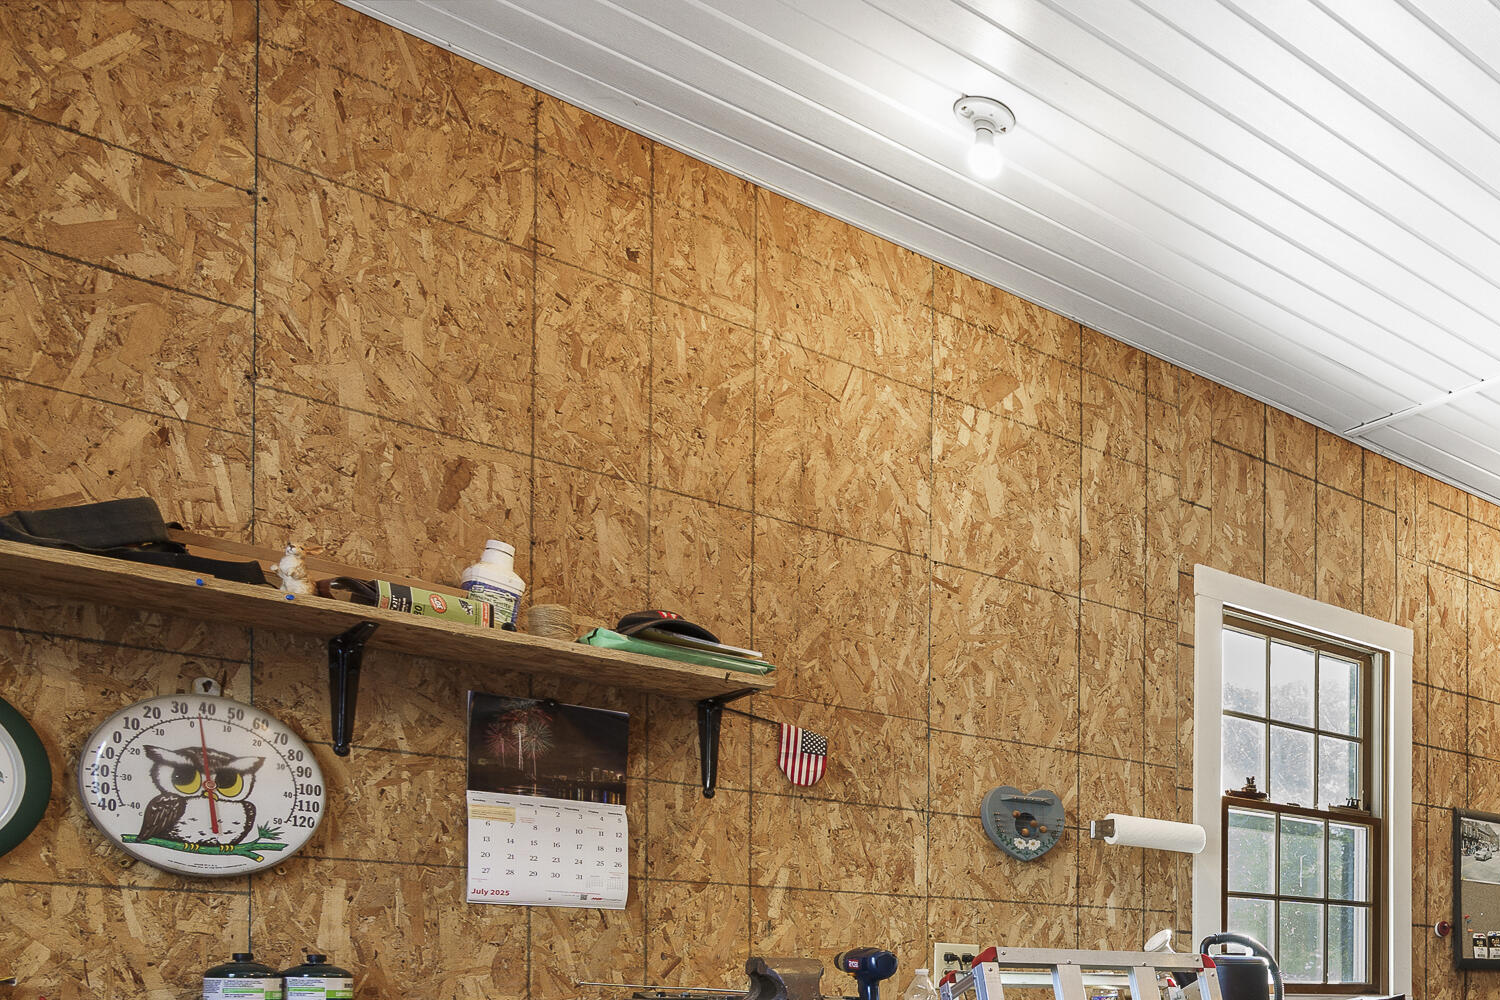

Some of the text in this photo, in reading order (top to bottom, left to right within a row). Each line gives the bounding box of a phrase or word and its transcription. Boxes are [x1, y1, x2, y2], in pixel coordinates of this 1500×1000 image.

[142, 705, 161, 720] 20
[170, 701, 189, 715] 30
[198, 702, 217, 716] 40
[227, 707, 245, 722] 50
[123, 716, 140, 731] 10
[252, 716, 270, 731] 60
[112, 730, 122, 744] 0
[273, 732, 289, 745] 70
[90, 746, 115, 760] -10
[287, 749, 304, 763] 80
[85, 764, 110, 778] -20
[296, 766, 312, 779] 90
[299, 784, 322, 797] 100
[90, 798, 117, 812] -40
[298, 801, 320, 813] 110
[292, 815, 315, 829] 120
[483, 835, 491, 843] 13
[471, 888, 510, 897] July 2025
